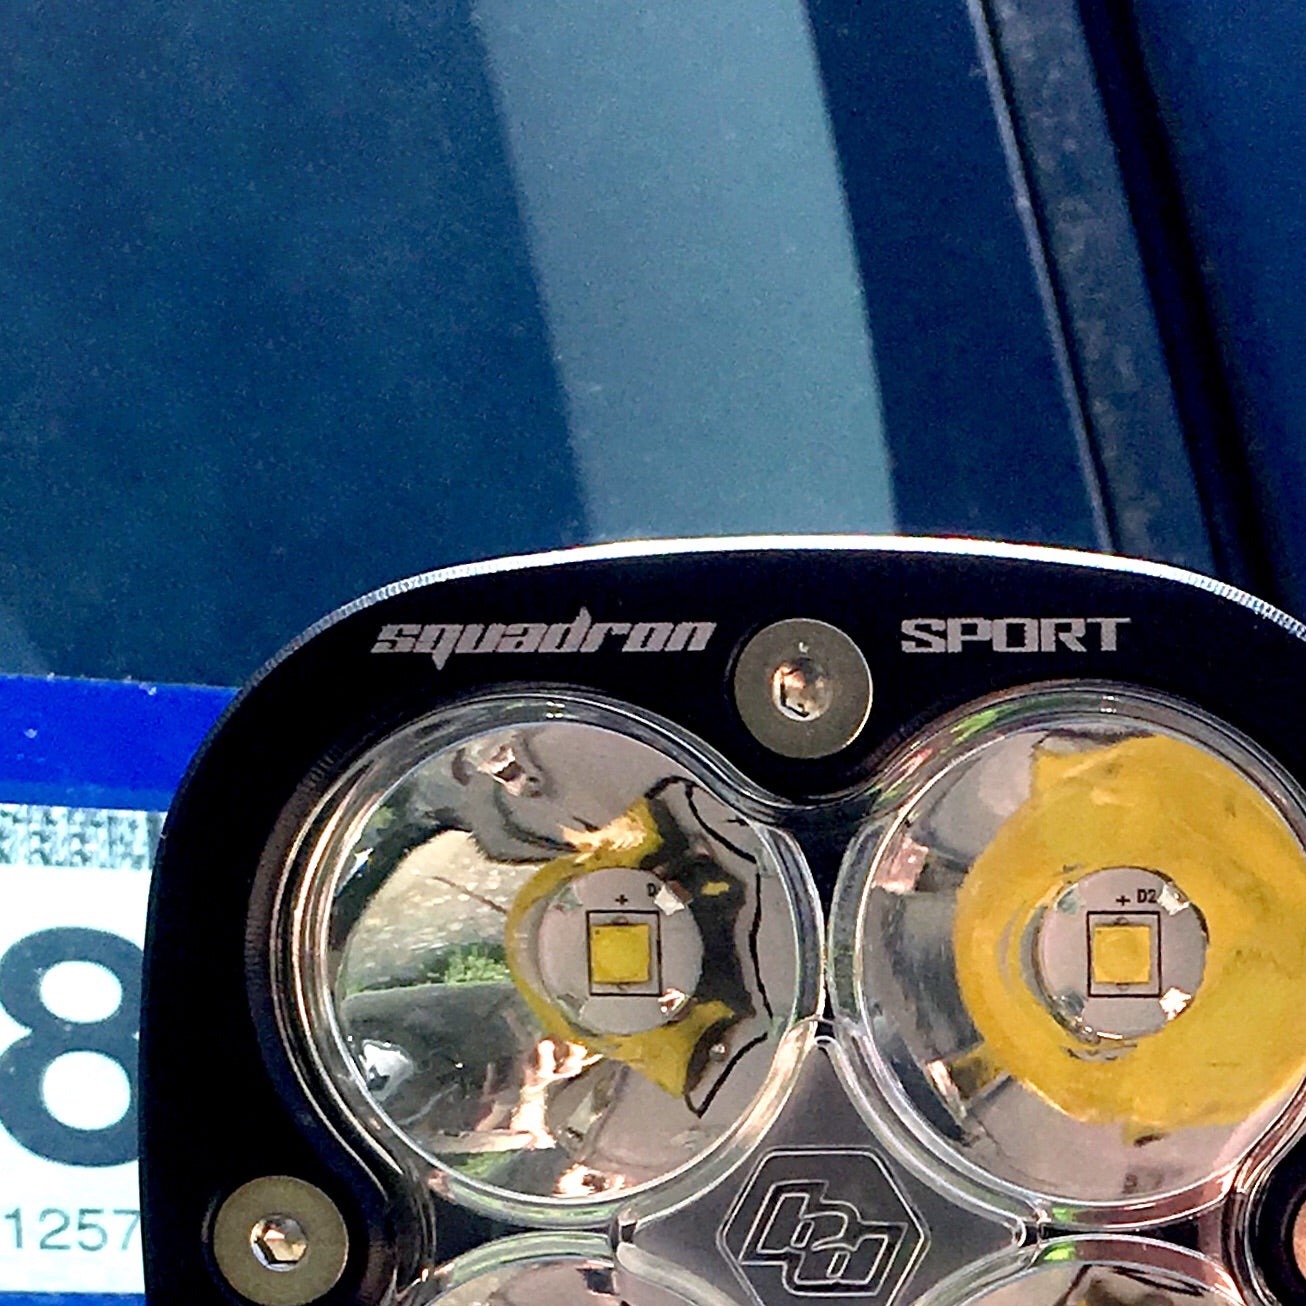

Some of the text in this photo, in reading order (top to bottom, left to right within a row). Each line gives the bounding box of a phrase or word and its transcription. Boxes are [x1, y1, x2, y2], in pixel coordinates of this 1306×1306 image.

[371, 606, 716, 670] squadron
[901, 617, 1131, 653] SPORT
[1136, 888, 1157, 904] D2
[0, 926, 143, 1168] 8
[4, 1207, 141, 1252] 1257
